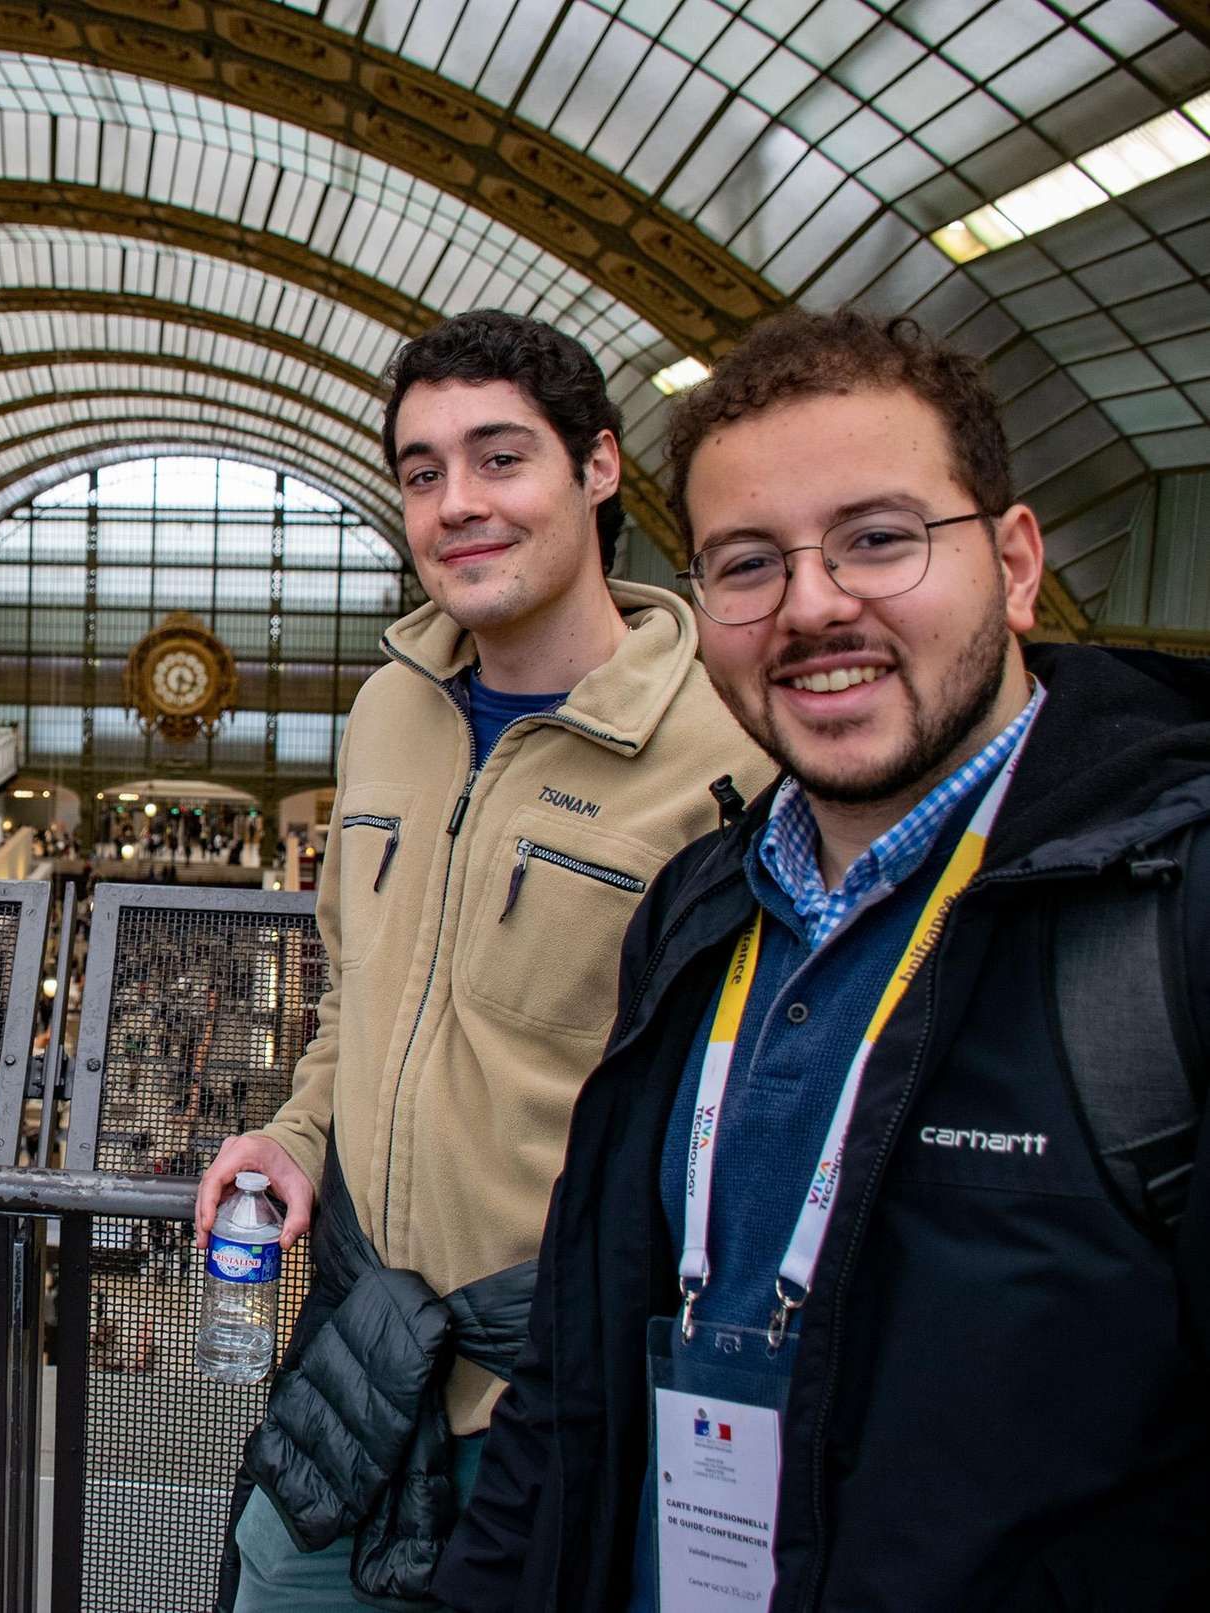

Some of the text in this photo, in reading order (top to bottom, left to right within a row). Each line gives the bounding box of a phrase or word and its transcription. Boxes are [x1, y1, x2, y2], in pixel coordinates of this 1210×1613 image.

[538, 786, 601, 818] TSUNAMI
[732, 921, 756, 984] france
[699, 1105, 716, 1149] VIVA
[920, 1125, 1048, 1155] carhartt
[688, 1105, 704, 1198] TECHNOLOGY
[807, 1161, 831, 1204] VIVA
[666, 1499, 769, 1531] CARTE PROFESSIONNELLE
[668, 1516, 678, 1525] DE
